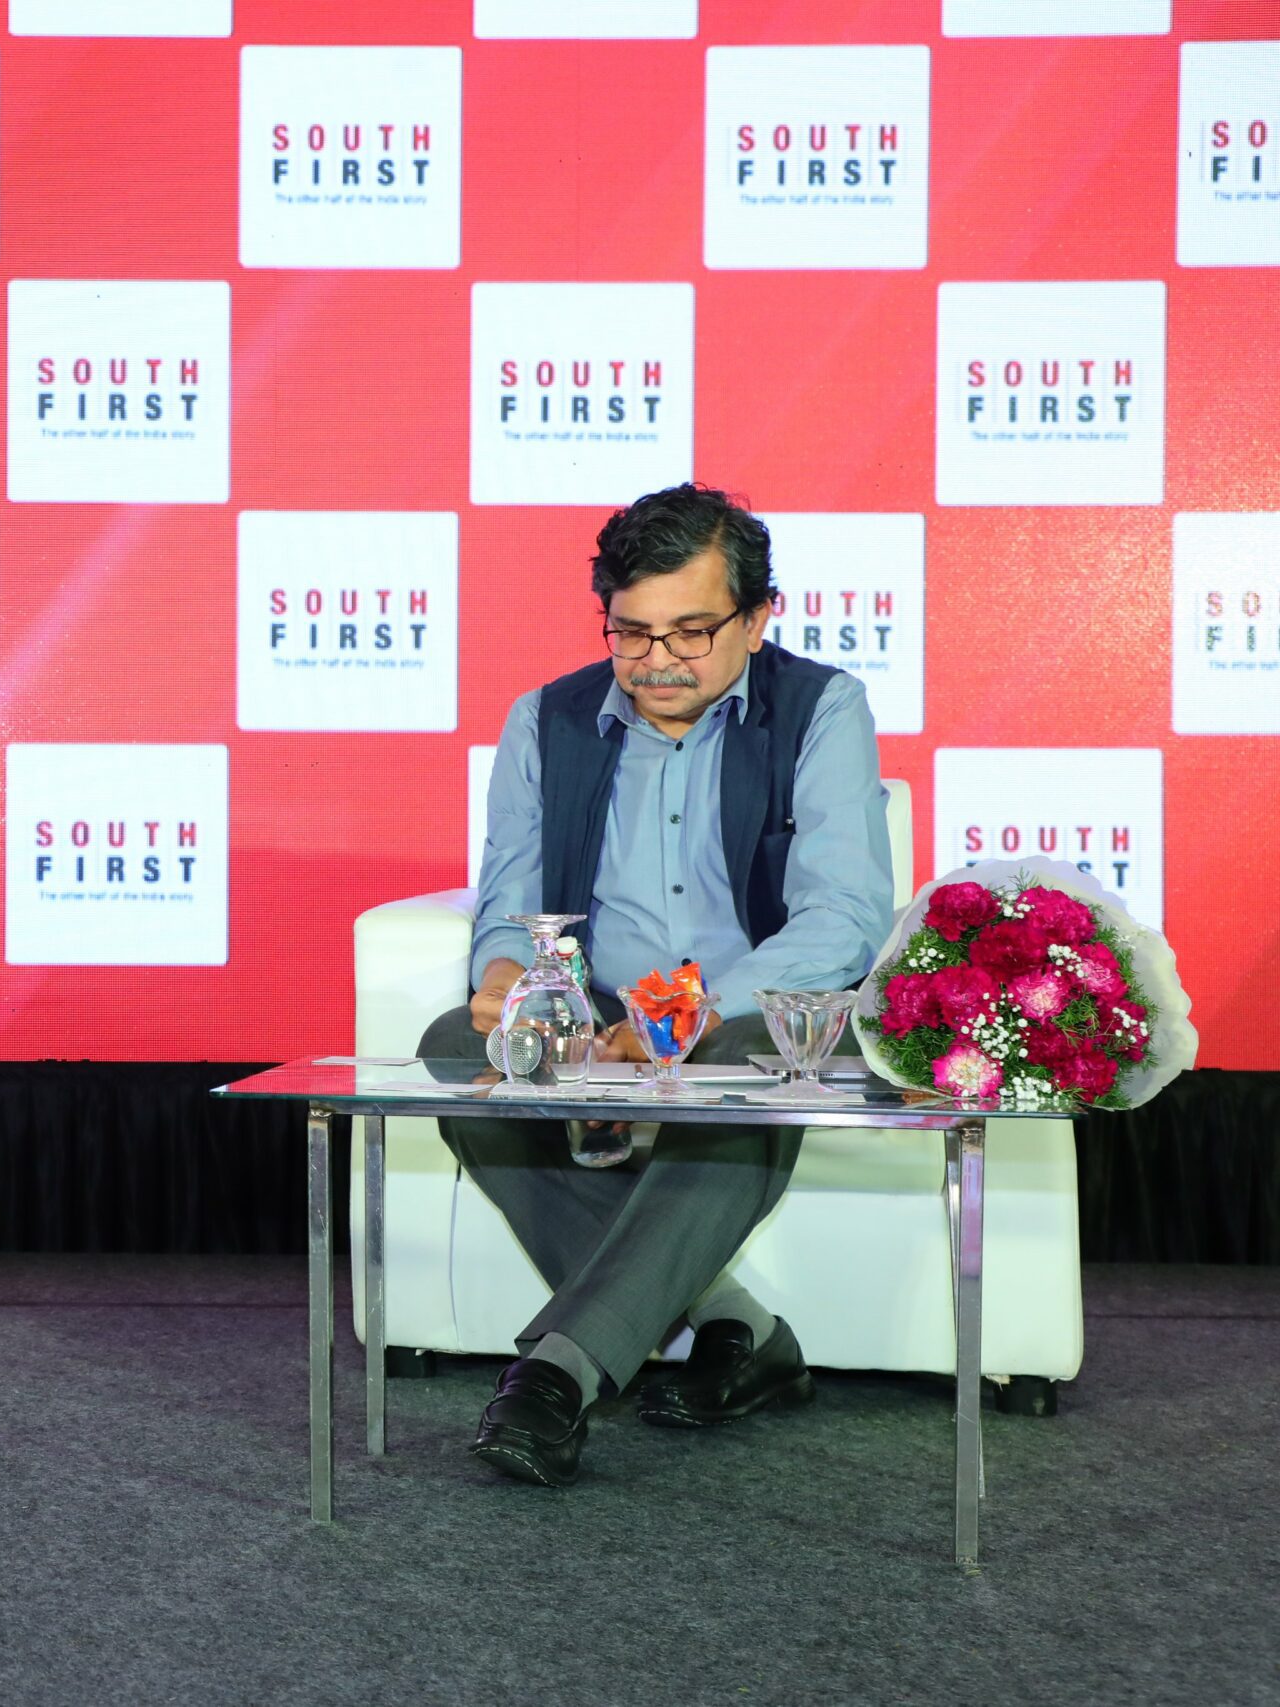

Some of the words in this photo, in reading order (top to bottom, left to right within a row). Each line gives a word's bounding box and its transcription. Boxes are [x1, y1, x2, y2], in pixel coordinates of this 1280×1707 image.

[273, 124, 430, 151] SOUTH
[738, 125, 897, 151] SOUTH
[273, 159, 429, 186] FIRST
[737, 160, 897, 186] FIRST
[274, 194, 292, 204] The
[740, 195, 757, 204] The
[38, 358, 198, 385] SOUTH
[500, 361, 662, 387] SOUTH
[968, 360, 1132, 388] SOUTH
[38, 393, 197, 420] FIRST
[500, 396, 660, 423] FIRST
[967, 395, 1131, 423] FIRST
[40, 429, 58, 438] The
[504, 432, 521, 441] The
[970, 432, 989, 441] The
[271, 589, 427, 615] SOUTH
[772, 591, 892, 617] OUTH
[271, 624, 426, 649] FIRST
[774, 625, 892, 651] IRST
[272, 659, 290, 667] The
[36, 822, 197, 847] SOUTH
[965, 826, 1130, 853] SOUTH
[35, 856, 196, 883] FIRST
[40, 892, 57, 901] The
